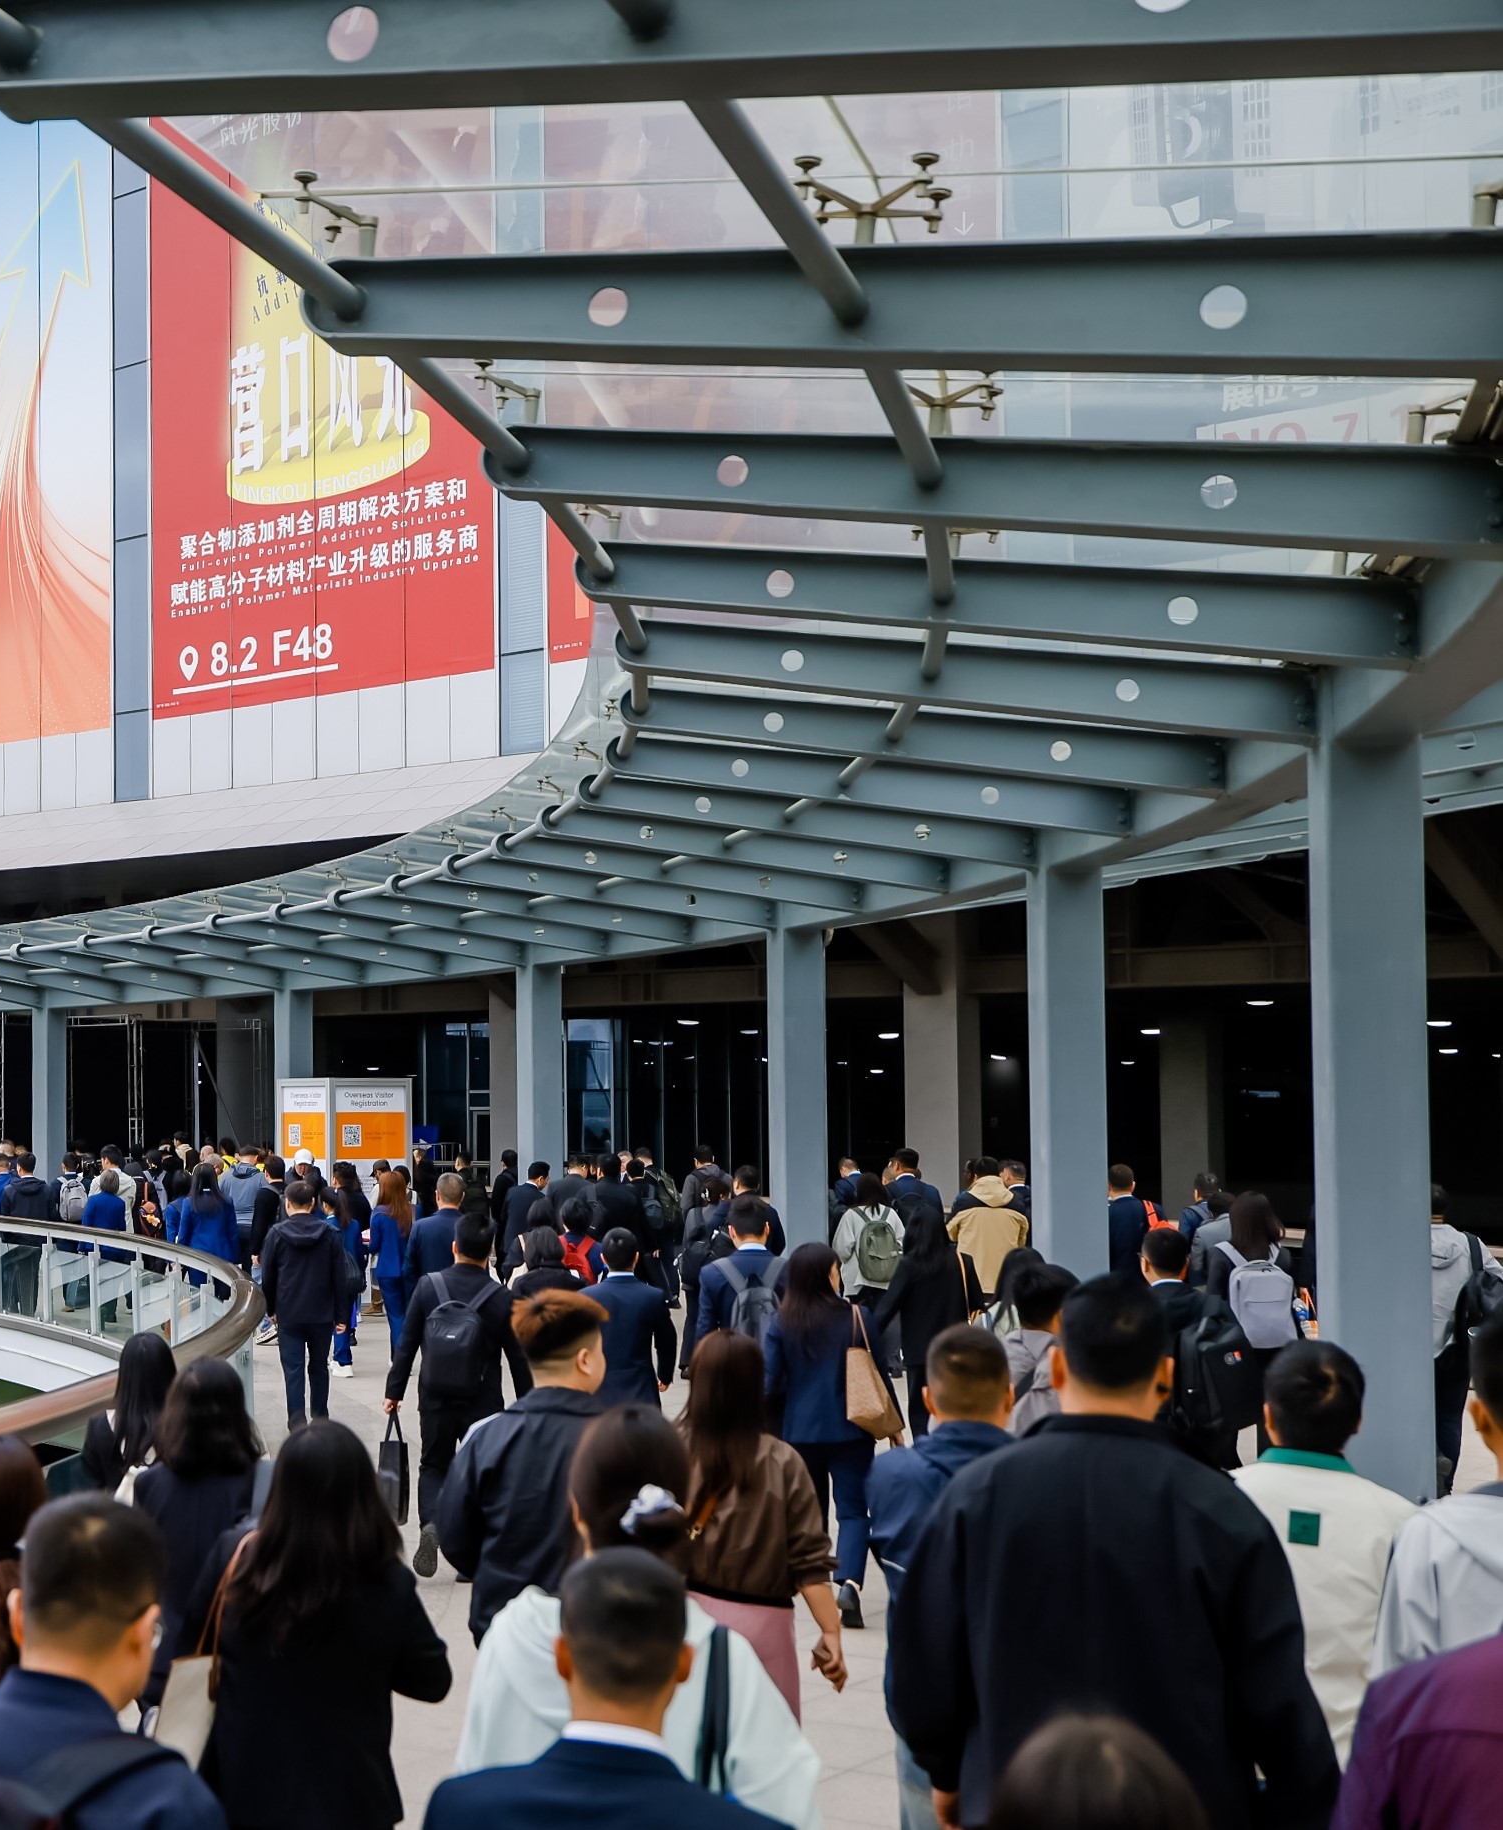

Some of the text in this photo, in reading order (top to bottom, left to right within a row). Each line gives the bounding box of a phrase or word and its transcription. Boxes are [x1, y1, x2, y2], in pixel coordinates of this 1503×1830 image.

[233, 437, 425, 502] YINGKOU FENGGUANG
[180, 478, 467, 559] 聚合物添加剂全周期解决方案和
[181, 508, 465, 572] Full-cycle Polymer Additive Solutions
[171, 524, 479, 607] 赋能高分子材料产业升级的服务商
[171, 553, 479, 618] Enabler of Polymer Materials Industry Upgrade
[210, 623, 333, 677] 8.2 F48
[294, 1100, 318, 1108] Registration
[344, 1091, 394, 1099] Overseas Visitor
[351, 1099, 388, 1108] Registration
